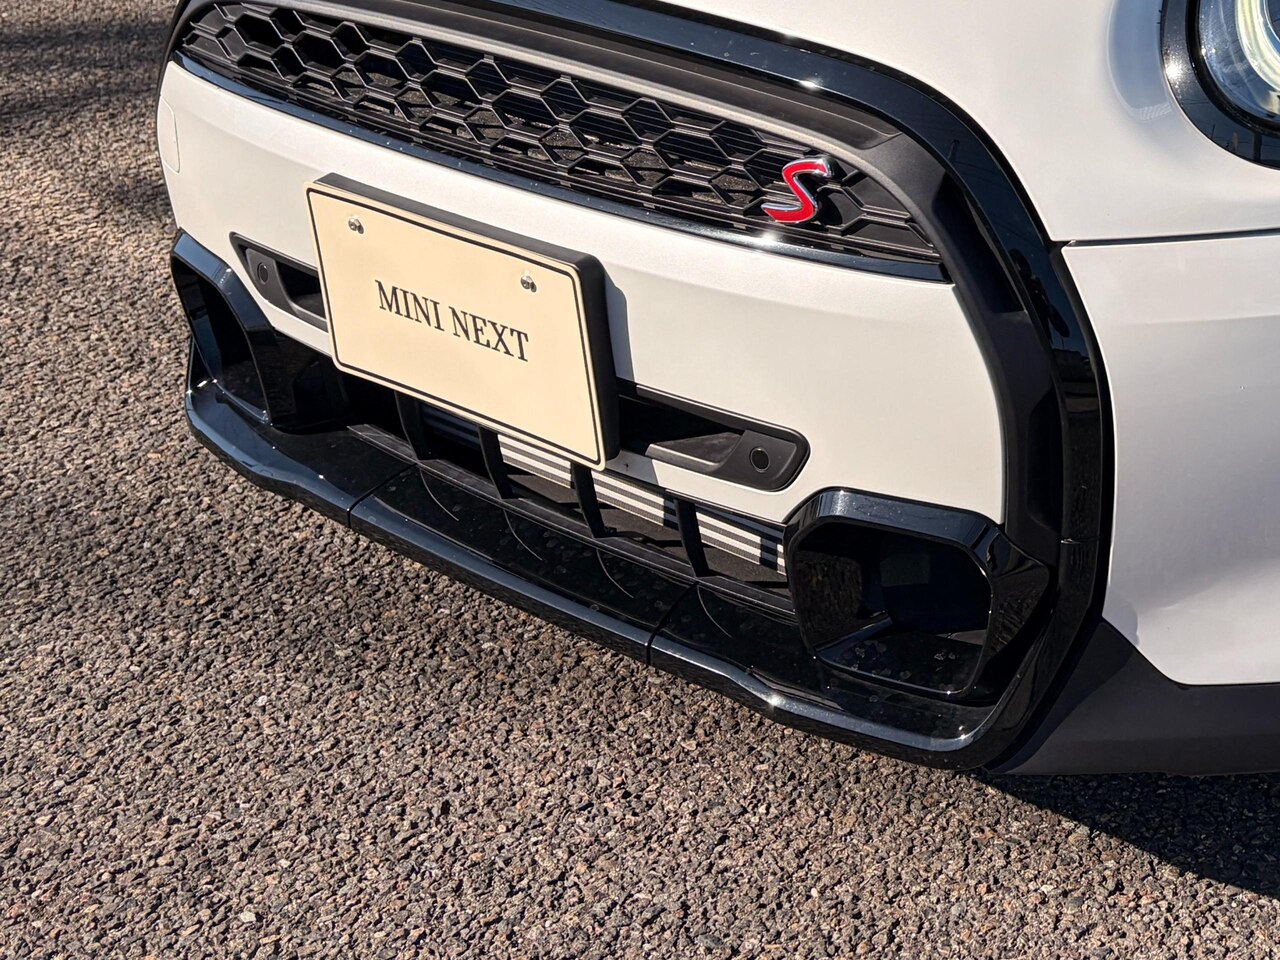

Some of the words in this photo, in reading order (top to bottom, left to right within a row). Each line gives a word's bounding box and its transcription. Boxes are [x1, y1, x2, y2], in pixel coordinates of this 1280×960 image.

[761, 157, 832, 225] S
[375, 279, 445, 332] MINI
[448, 305, 529, 362] NEXT
